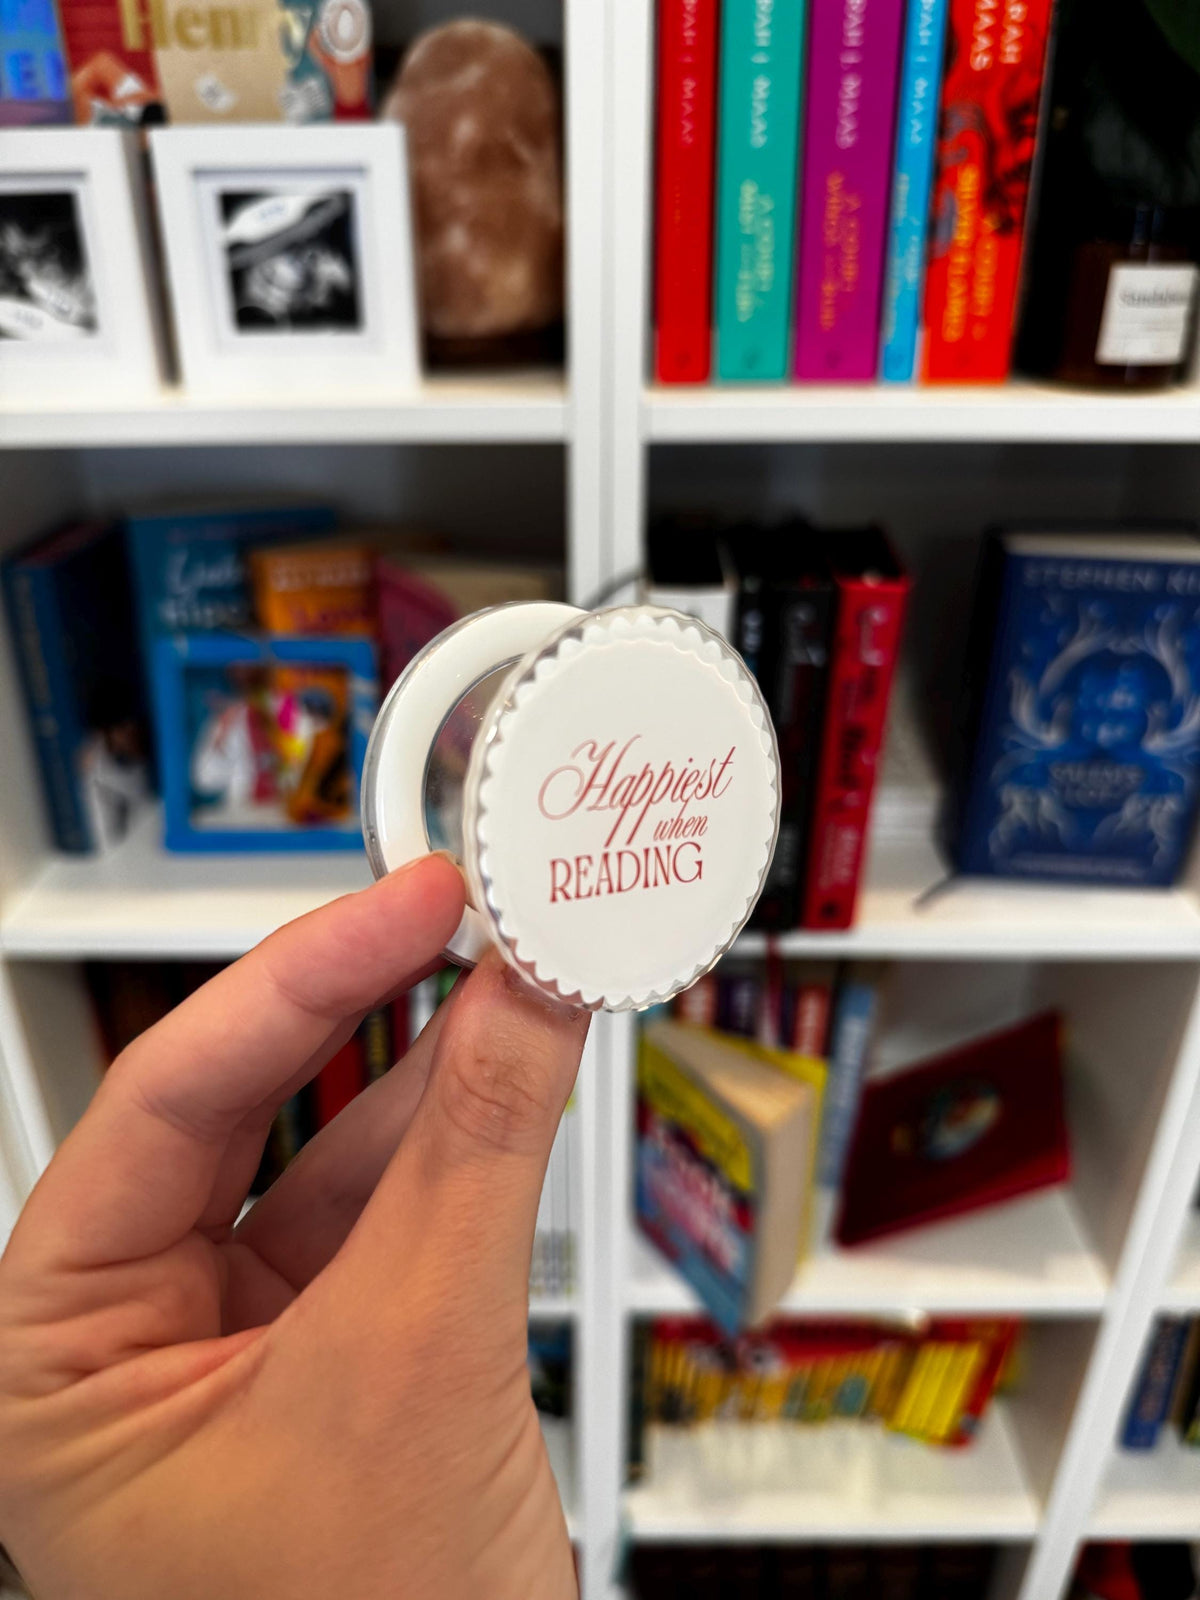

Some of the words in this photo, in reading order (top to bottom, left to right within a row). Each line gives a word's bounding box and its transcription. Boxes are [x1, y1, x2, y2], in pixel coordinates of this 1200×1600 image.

[538, 734, 736, 849] Happiest
[653, 801, 709, 842] when
[549, 841, 703, 903] READING
